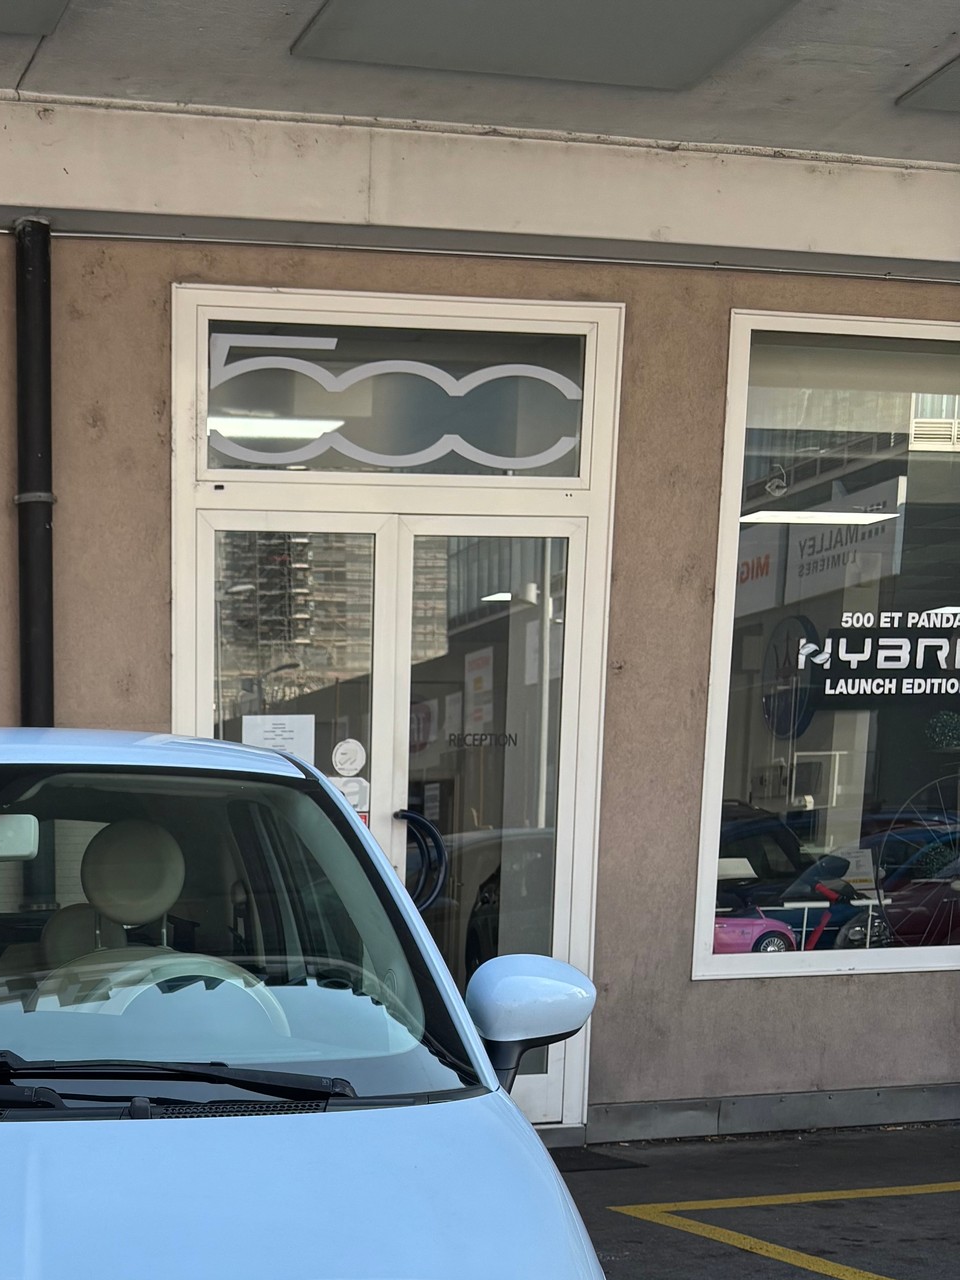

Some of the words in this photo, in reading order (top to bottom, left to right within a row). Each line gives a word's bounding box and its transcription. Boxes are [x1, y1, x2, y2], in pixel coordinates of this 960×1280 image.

[208, 332, 582, 470] 500
[841, 612, 874, 628] 500
[879, 612, 902, 628] ET
[824, 678, 897, 695] LAUNCH
[901, 678, 960, 695] EDITIO
[448, 733, 518, 748] RECEPTION
